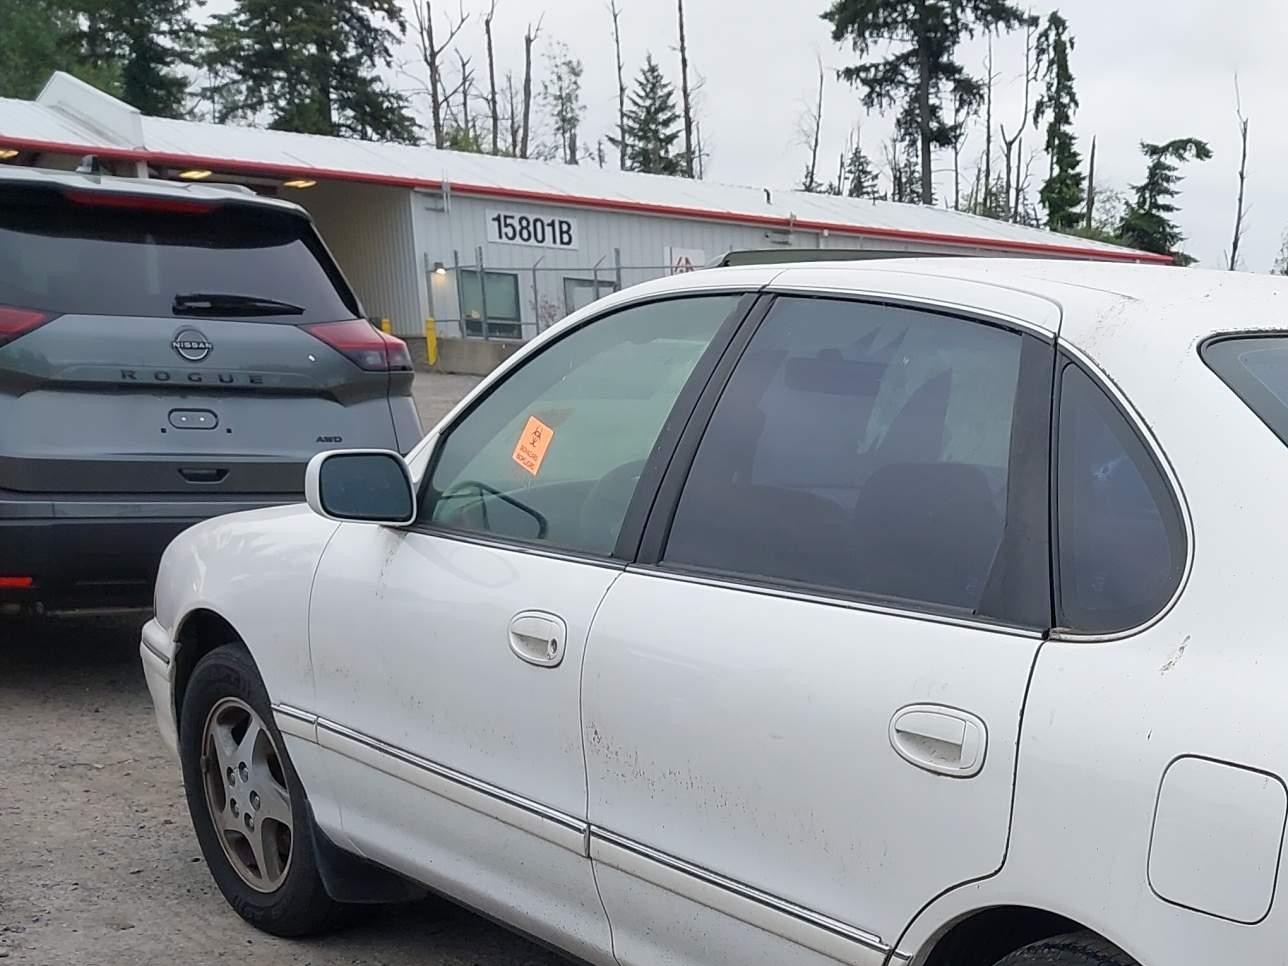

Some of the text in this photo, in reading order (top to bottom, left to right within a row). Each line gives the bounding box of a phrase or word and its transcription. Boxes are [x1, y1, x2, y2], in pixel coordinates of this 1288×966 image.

[492, 213, 573, 246] 15801B
[172, 341, 213, 350] NISSAN
[120, 368, 264, 385] ROGUE
[315, 435, 343, 444] AWD
